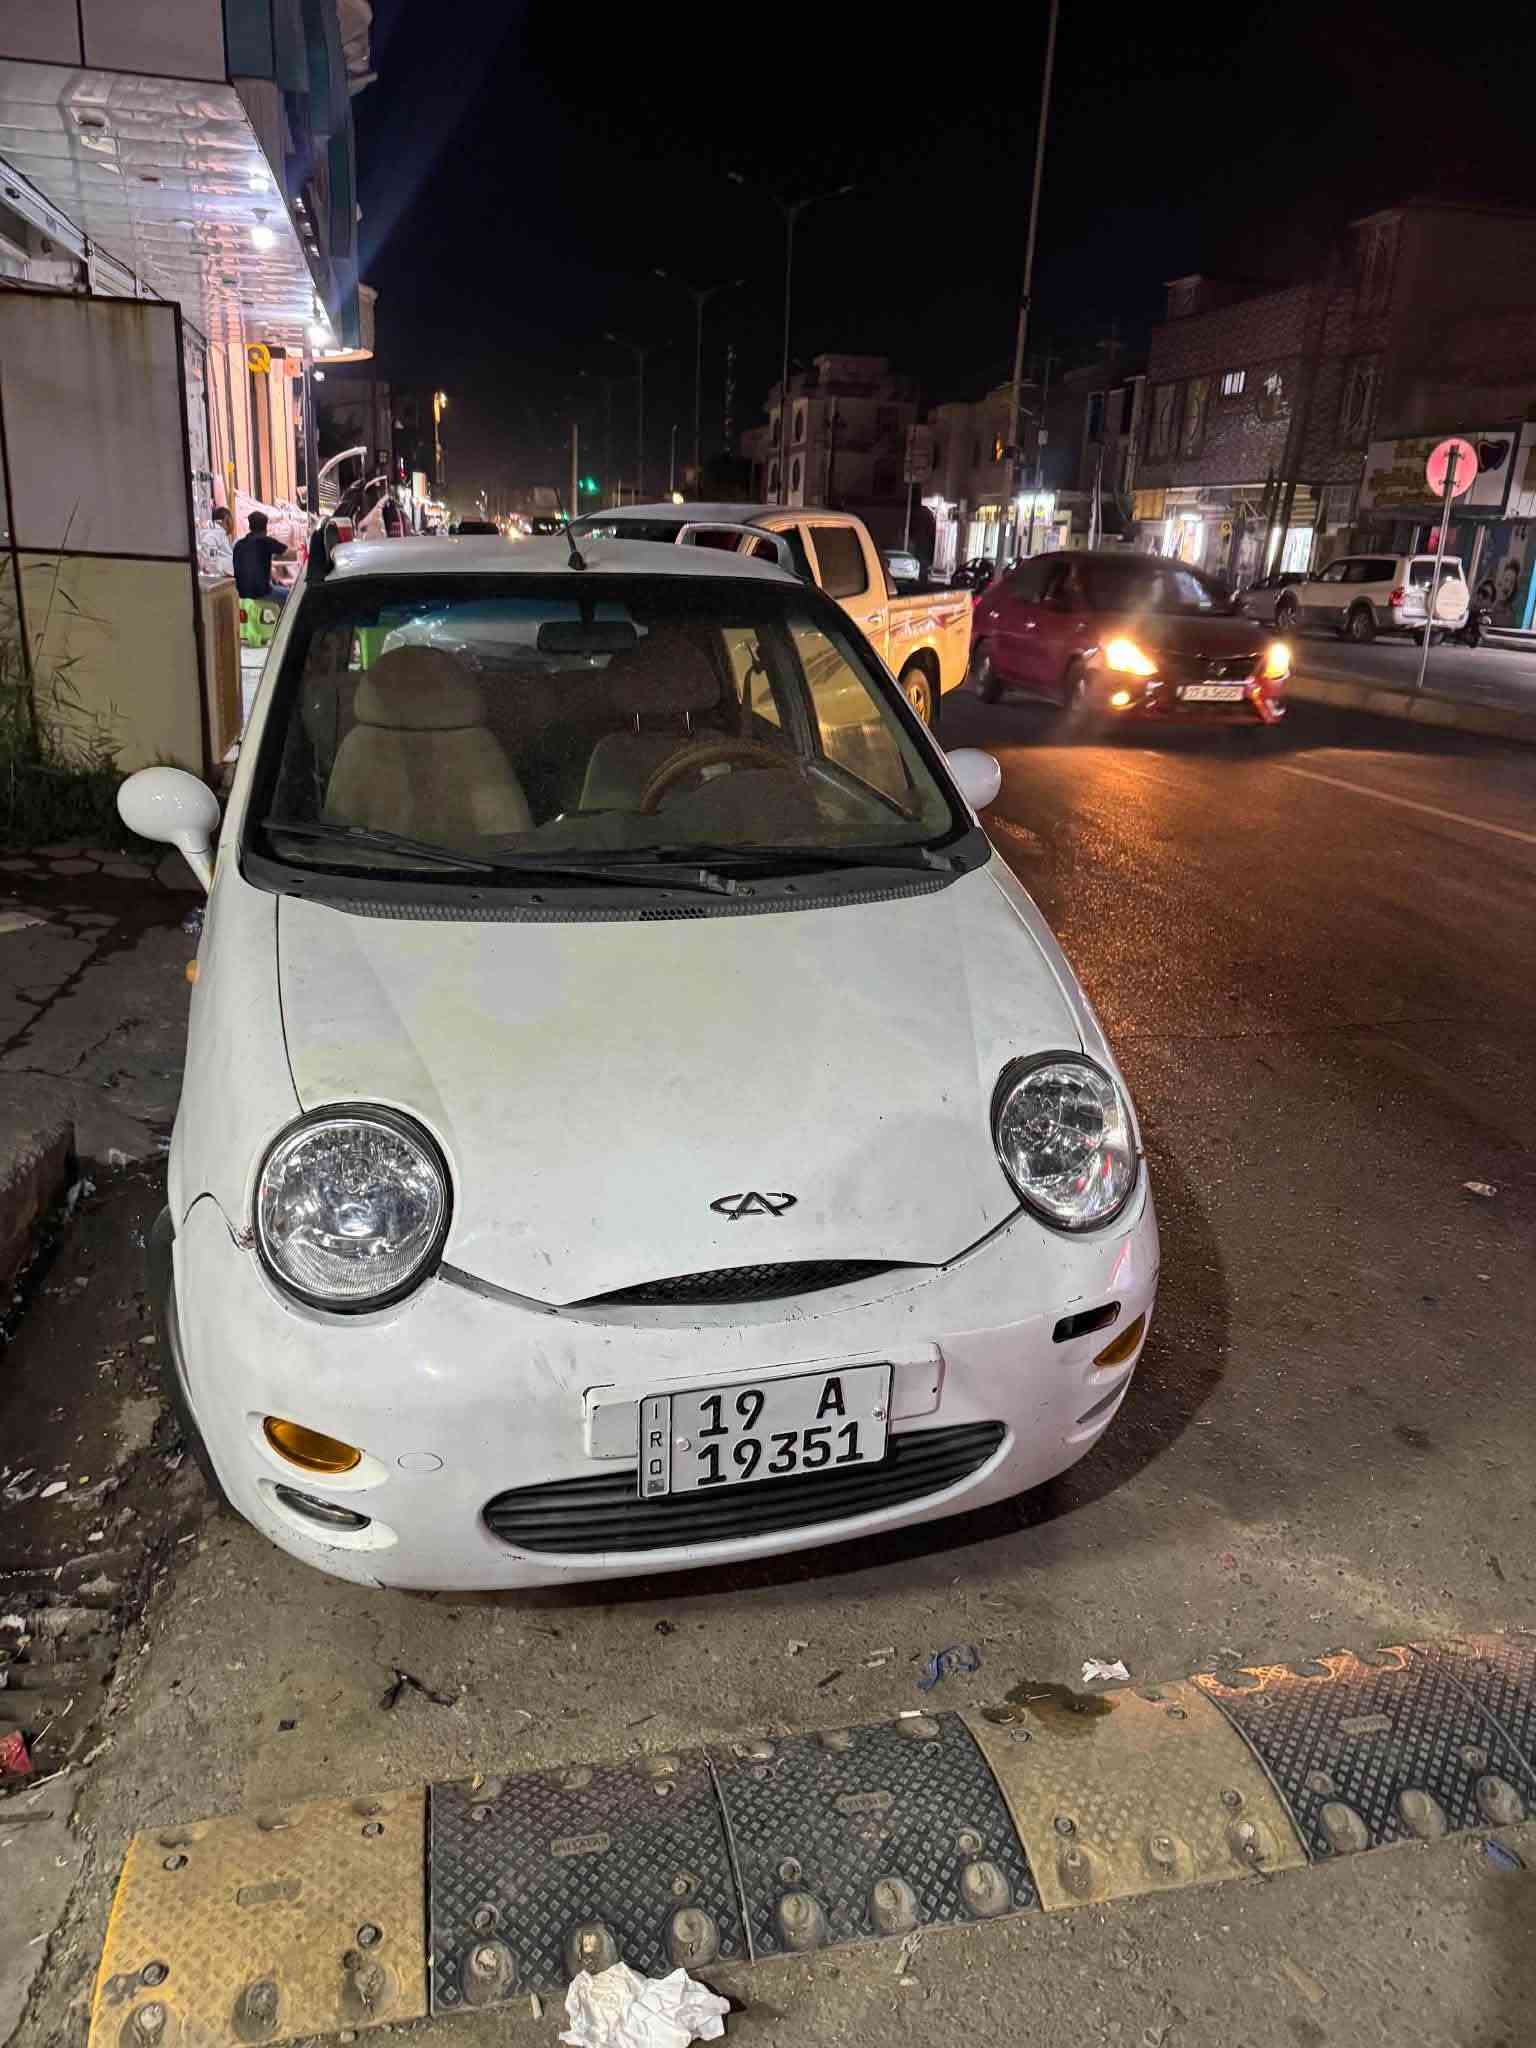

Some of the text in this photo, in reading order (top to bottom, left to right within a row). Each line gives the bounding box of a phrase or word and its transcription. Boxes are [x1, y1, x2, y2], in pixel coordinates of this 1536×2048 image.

[698, 1376, 846, 1438] 19 A
[697, 1421, 864, 1486] 19351
